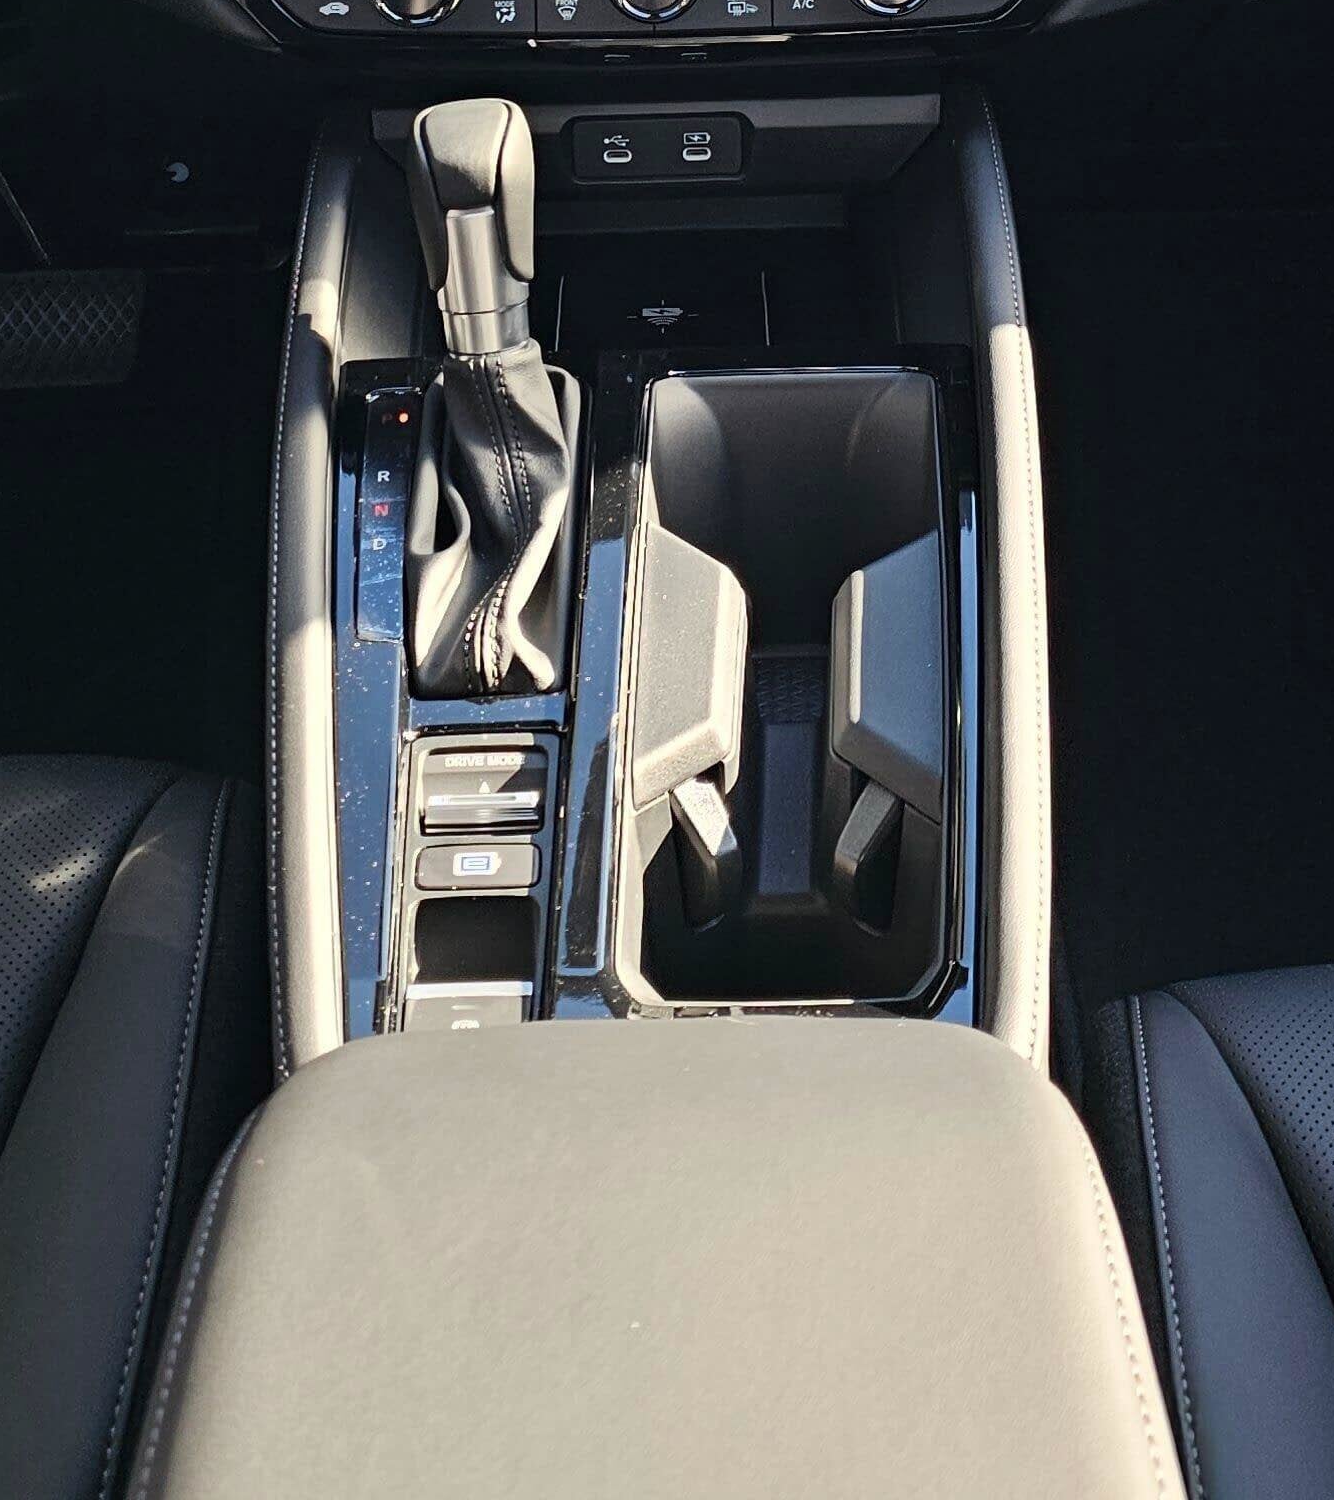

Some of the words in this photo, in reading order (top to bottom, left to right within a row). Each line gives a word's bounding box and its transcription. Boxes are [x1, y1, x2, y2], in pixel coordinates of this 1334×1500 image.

[377, 470, 391, 483] R
[374, 505, 389, 516] N
[372, 538, 387, 550] D
[444, 755, 485, 767] DRIVE
[486, 755, 526, 766] MODE
